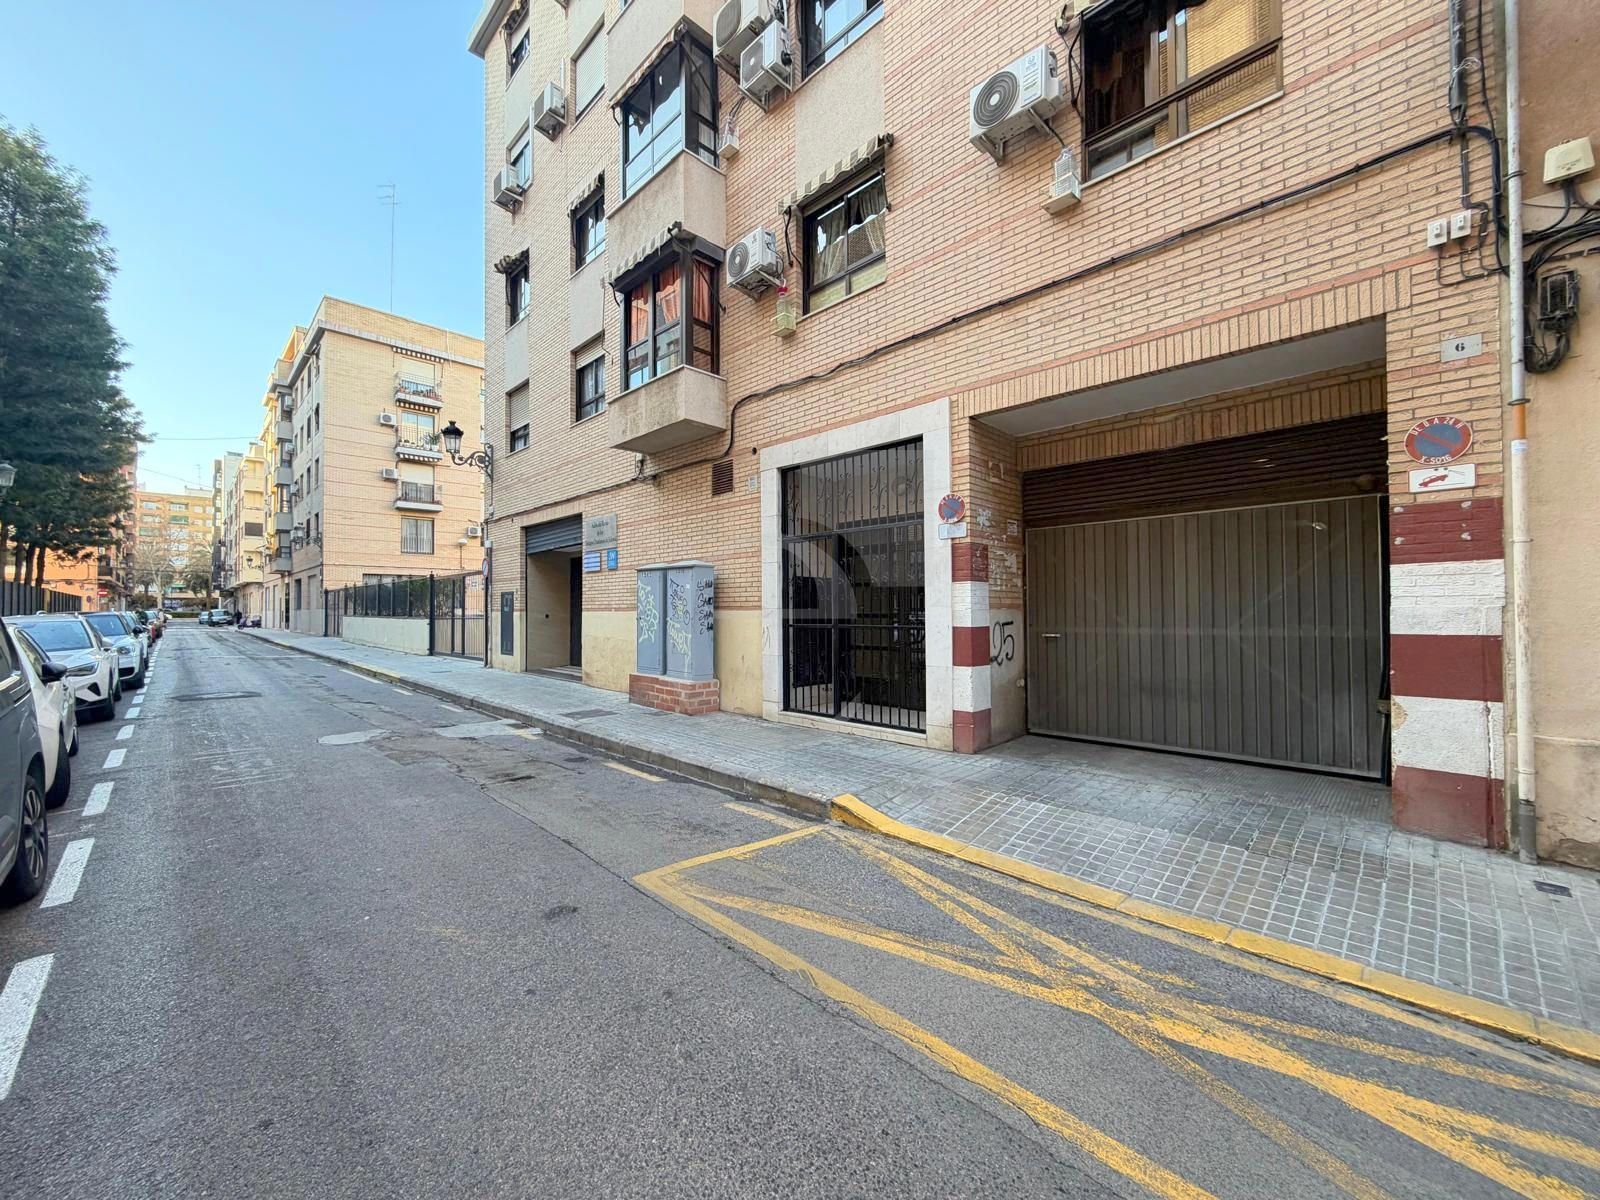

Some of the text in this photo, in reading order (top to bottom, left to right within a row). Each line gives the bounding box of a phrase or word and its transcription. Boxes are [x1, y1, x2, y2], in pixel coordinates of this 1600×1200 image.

[1455, 342, 1465, 352] 6
[1433, 417, 1439, 425] A
[1443, 416, 1456, 425] 24
[989, 620, 1015, 667] 25
